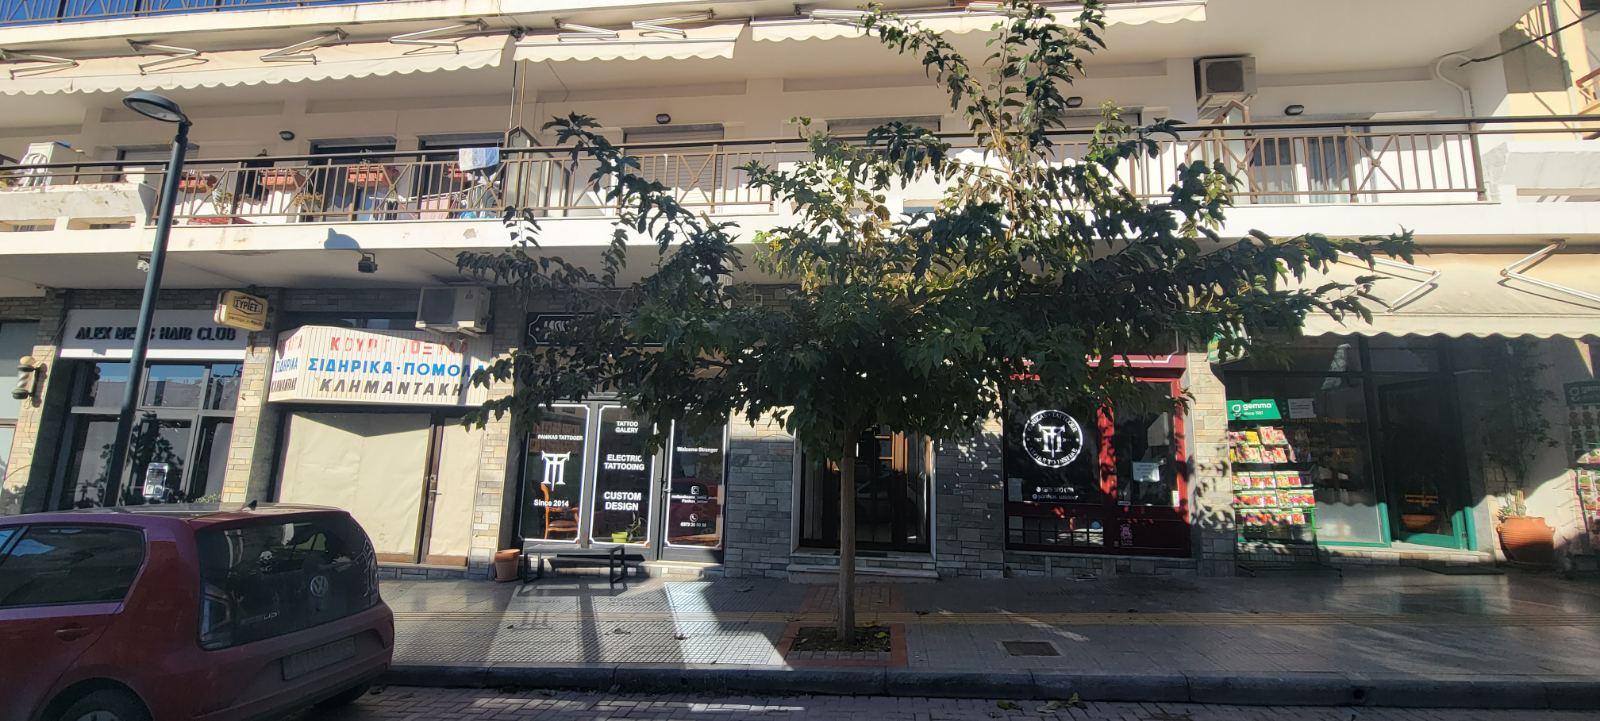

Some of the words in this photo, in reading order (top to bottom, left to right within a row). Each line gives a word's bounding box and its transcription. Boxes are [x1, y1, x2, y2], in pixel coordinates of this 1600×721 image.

[75, 326, 112, 340] ALEX
[159, 327, 193, 340] HAIR
[197, 327, 236, 341] CLUB
[319, 378, 463, 397] ΚΛΗΜΑΝΤΑΚΗ
[606, 453, 643, 463] ELECTRIC
[604, 462, 645, 471] TATTOOING
[603, 491, 642, 501] CUSTOM
[533, 499, 553, 507] Since
[553, 499, 569, 507] 2014
[605, 501, 639, 511] DESIGN
